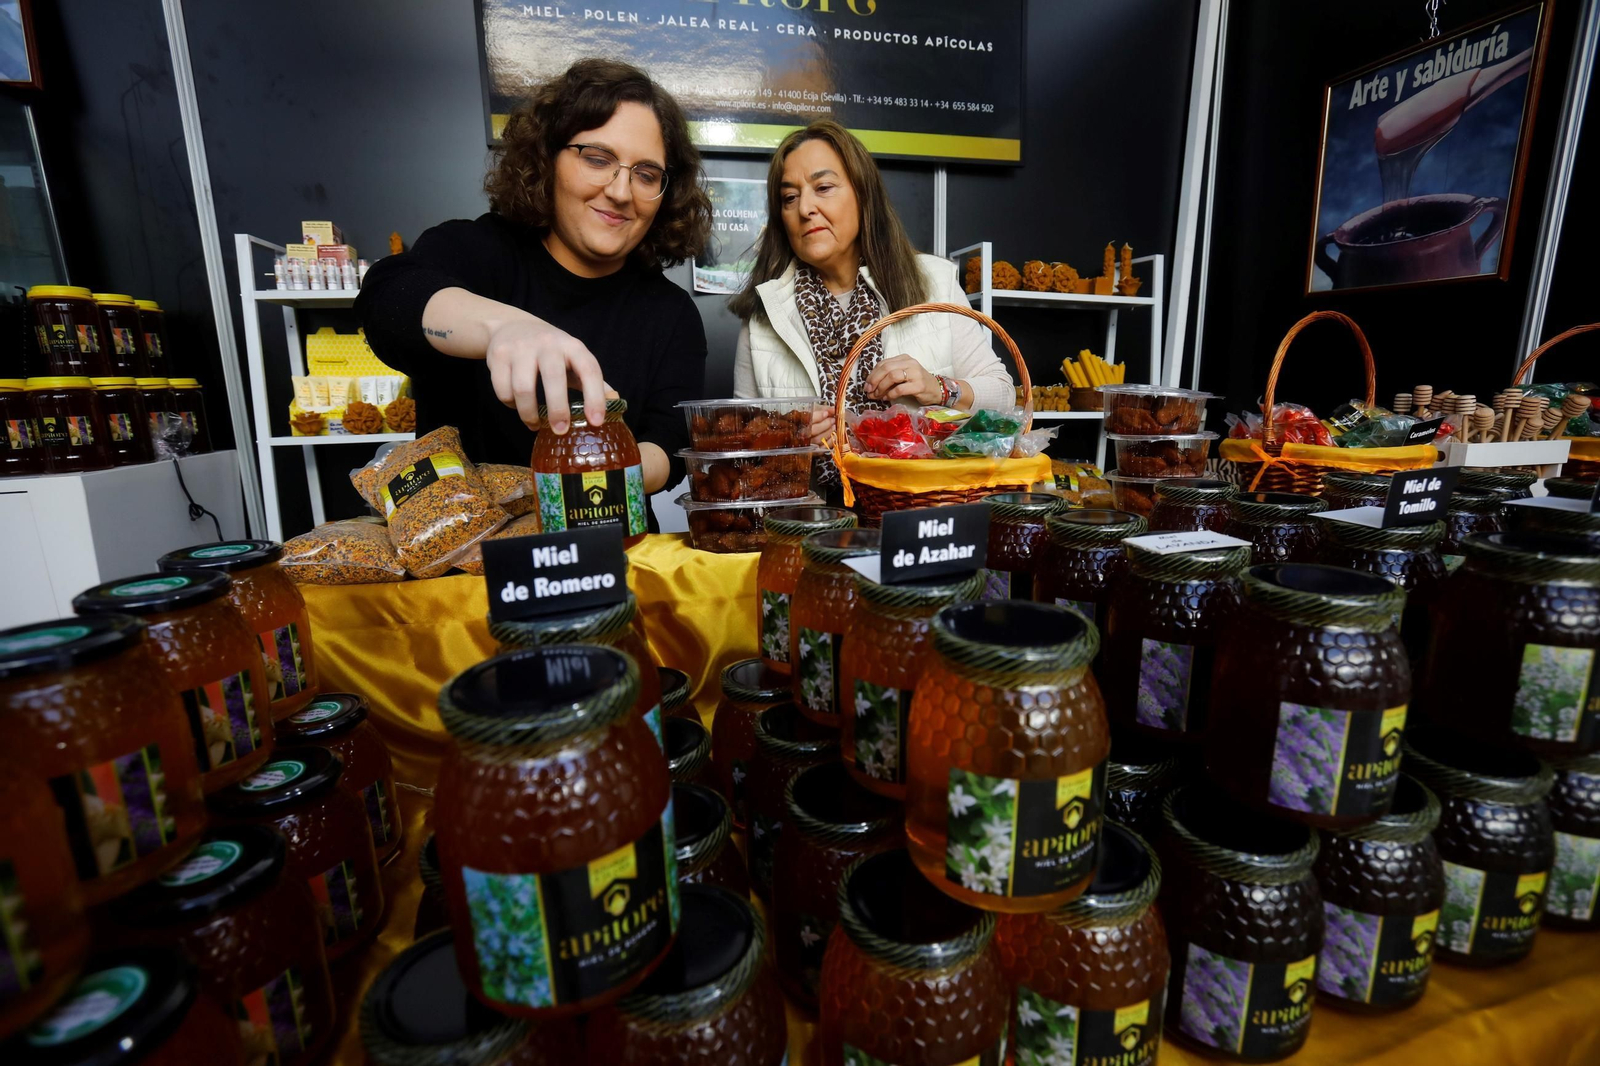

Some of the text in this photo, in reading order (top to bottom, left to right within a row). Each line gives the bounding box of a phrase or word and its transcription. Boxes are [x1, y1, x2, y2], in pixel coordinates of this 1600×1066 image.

[523, 5, 994, 52] MIEL POLEN JALEA REAL CERA PRODUCTOS APÍCOLAS
[1349, 24, 1510, 110] Arte y sabiduría
[758, 88, 772, 98] 149
[778, 89, 801, 100] 41400
[820, 91, 847, 105] (Sevilla)
[866, 96, 882, 105] +34
[883, 96, 893, 106] 95
[894, 97, 908, 107] 483
[909, 98, 918, 108] 33
[920, 99, 929, 108] 14
[934, 100, 949, 109] +34
[952, 101, 966, 111] 655
[967, 102, 980, 112] 584
[981, 103, 994, 113] 502
[722, 209, 758, 219] COLMENA
[717, 222, 727, 231] TU
[729, 223, 749, 232] CASA
[1402, 476, 1442, 495] Miel de
[1398, 497, 1437, 516] Tomillo
[917, 517, 954, 539] Miel
[531, 542, 579, 569] Miel
[892, 542, 976, 569] de Azahar
[500, 572, 616, 603] de Romero
